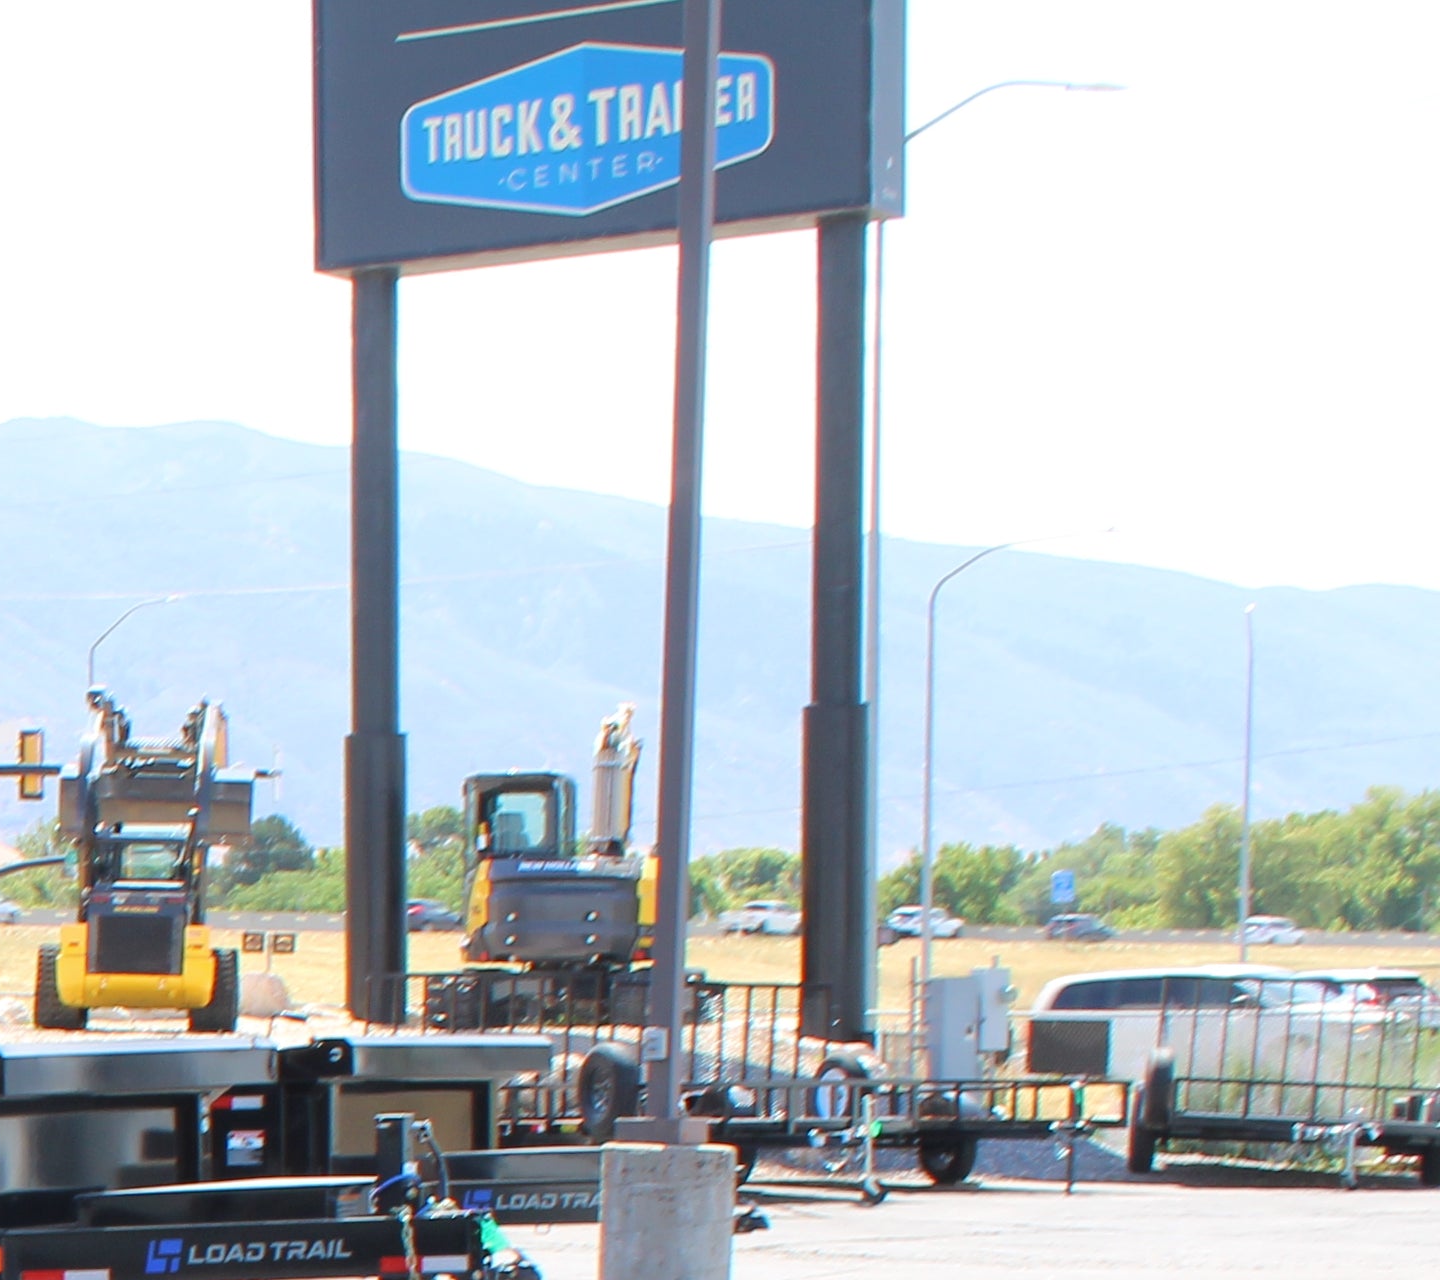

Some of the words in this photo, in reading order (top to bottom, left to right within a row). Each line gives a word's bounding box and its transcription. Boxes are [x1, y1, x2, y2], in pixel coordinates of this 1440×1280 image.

[422, 98, 543, 164] TRUCK
[586, 72, 757, 147] TRAIER
[506, 151, 656, 191] CENTER
[496, 1192, 558, 1211] LOAD
[560, 1190, 602, 1209] TRA
[186, 1241, 266, 1265] LOAD
[268, 1238, 353, 1262] TRAIL
